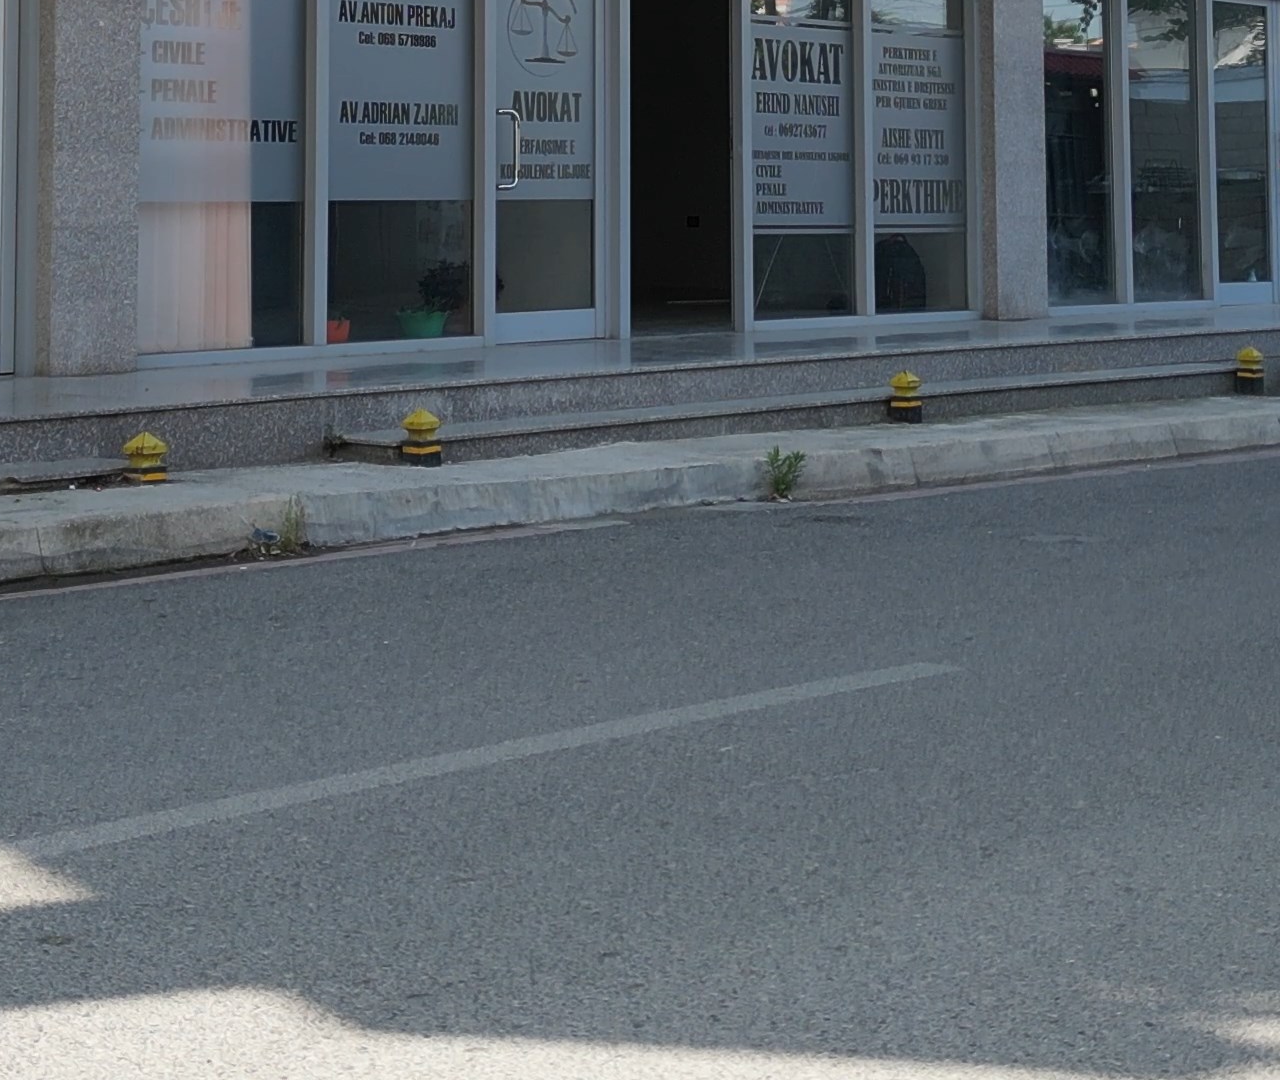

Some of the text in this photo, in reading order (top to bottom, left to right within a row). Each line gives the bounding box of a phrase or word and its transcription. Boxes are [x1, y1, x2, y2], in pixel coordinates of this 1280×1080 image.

[338, 0, 456, 29] AV.ANTON PREKAJ
[151, 40, 206, 65] CIVILE
[751, 37, 844, 85] AVOKAT
[151, 78, 217, 104] PENALE
[872, 79, 905, 92] INISTRIA
[908, 81, 913, 93] E
[511, 91, 582, 123] AVOKAT
[755, 91, 840, 117] ERIND NANUSHI
[876, 95, 891, 108] PER
[340, 101, 459, 126] AV.ADRIAN ZJARRI
[151, 117, 298, 143] ADMINISTRATIVE
[778, 123, 827, 139] 0692743677
[882, 128, 944, 149] AISHE SHYTI
[520, 137, 576, 156] ËRFAQSIME E
[500, 162, 591, 179] KOSULENCË LIGJORE
[756, 165, 782, 178] CIVILE
[756, 183, 787, 196] PENALE
[756, 201, 824, 214] ADMINISTRATIVE
